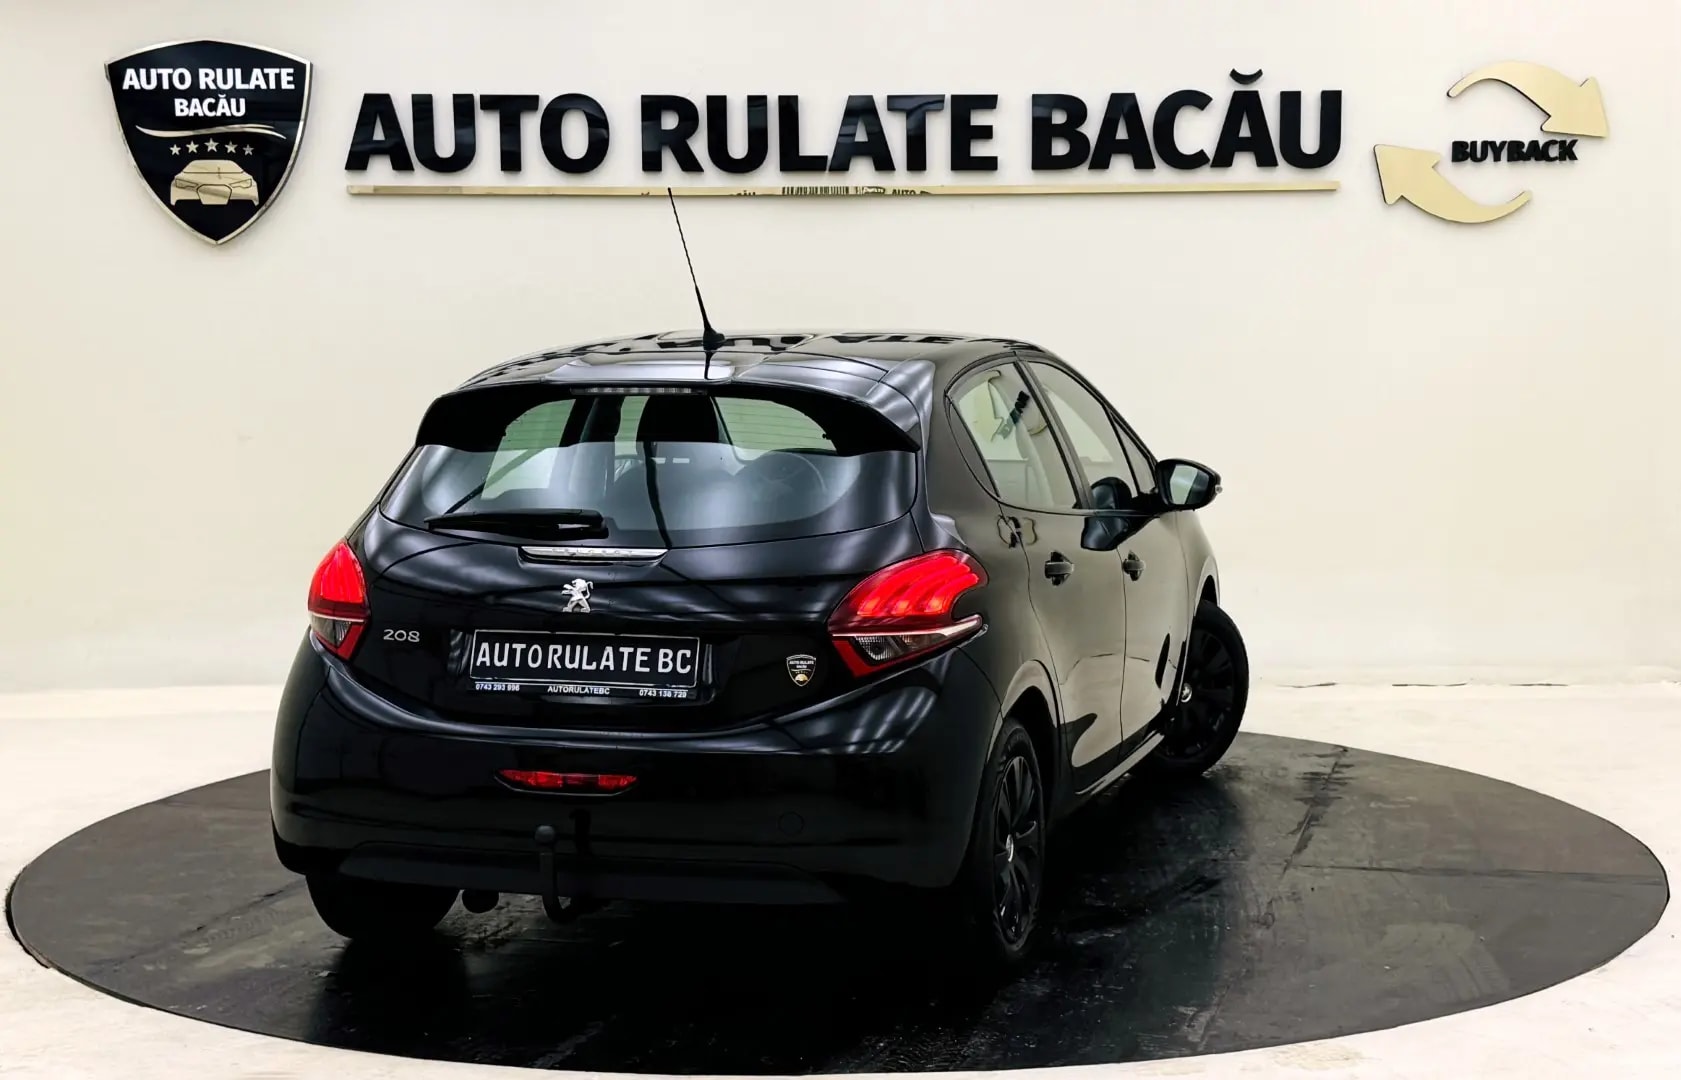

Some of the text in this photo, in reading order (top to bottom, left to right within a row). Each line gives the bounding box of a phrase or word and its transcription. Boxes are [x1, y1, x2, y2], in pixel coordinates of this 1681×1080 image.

[122, 68, 295, 90] AUTO RULATE
[174, 94, 246, 117] BACĂU
[345, 67, 1343, 174] AUTO RULATE BACĂU
[1451, 139, 1579, 163] BUYBACK
[383, 629, 421, 643] 208
[475, 642, 692, 674] AUTO RULATE BC
[475, 683, 492, 691] 0743
[547, 685, 610, 695] AUTORULATEBC
[639, 689, 657, 697] 0743
